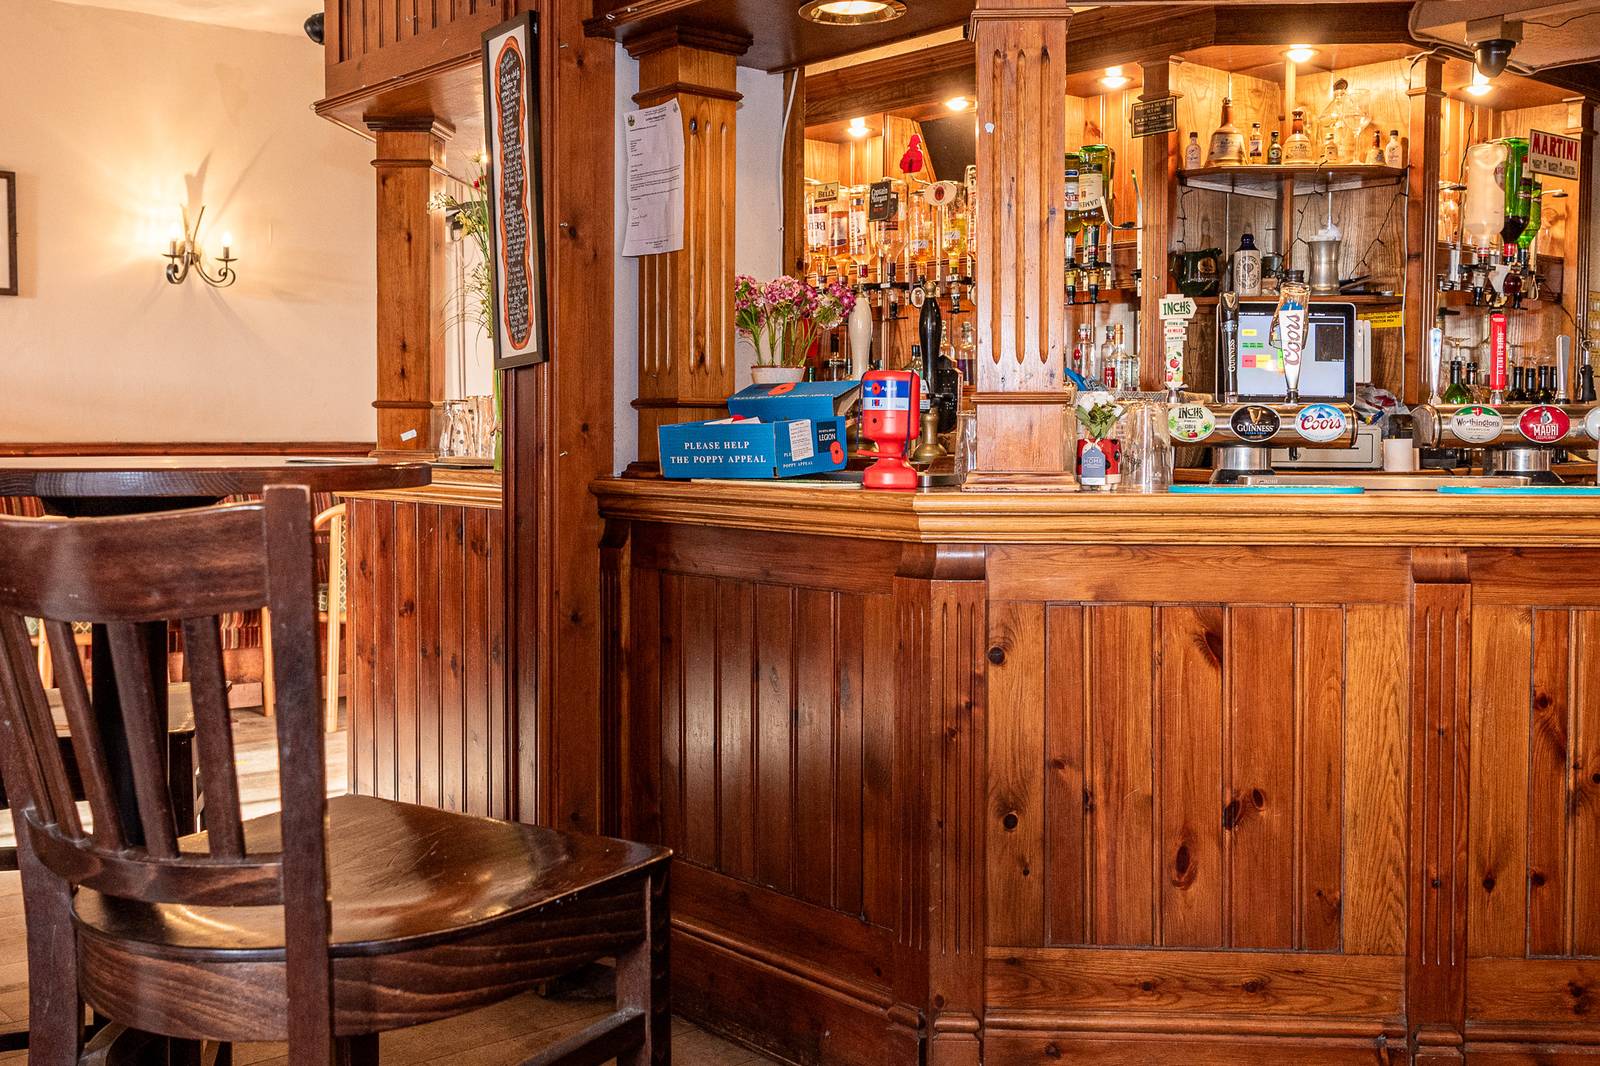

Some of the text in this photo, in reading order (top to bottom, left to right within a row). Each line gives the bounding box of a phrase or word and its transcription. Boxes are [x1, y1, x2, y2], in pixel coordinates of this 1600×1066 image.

[1532, 133, 1577, 161] MARTINI
[1163, 301, 1191, 316] INCH'S
[1284, 314, 1301, 366] Coors
[1228, 339, 1236, 373] GUINNESS
[1178, 407, 1204, 419] INCH'S
[1236, 423, 1275, 433] GUINNESS
[1300, 414, 1341, 431] Coors
[1456, 418, 1500, 428] Worthington's
[684, 441, 749, 450] PLEASE HELP
[670, 454, 767, 464] THE POPPY APPEAL
